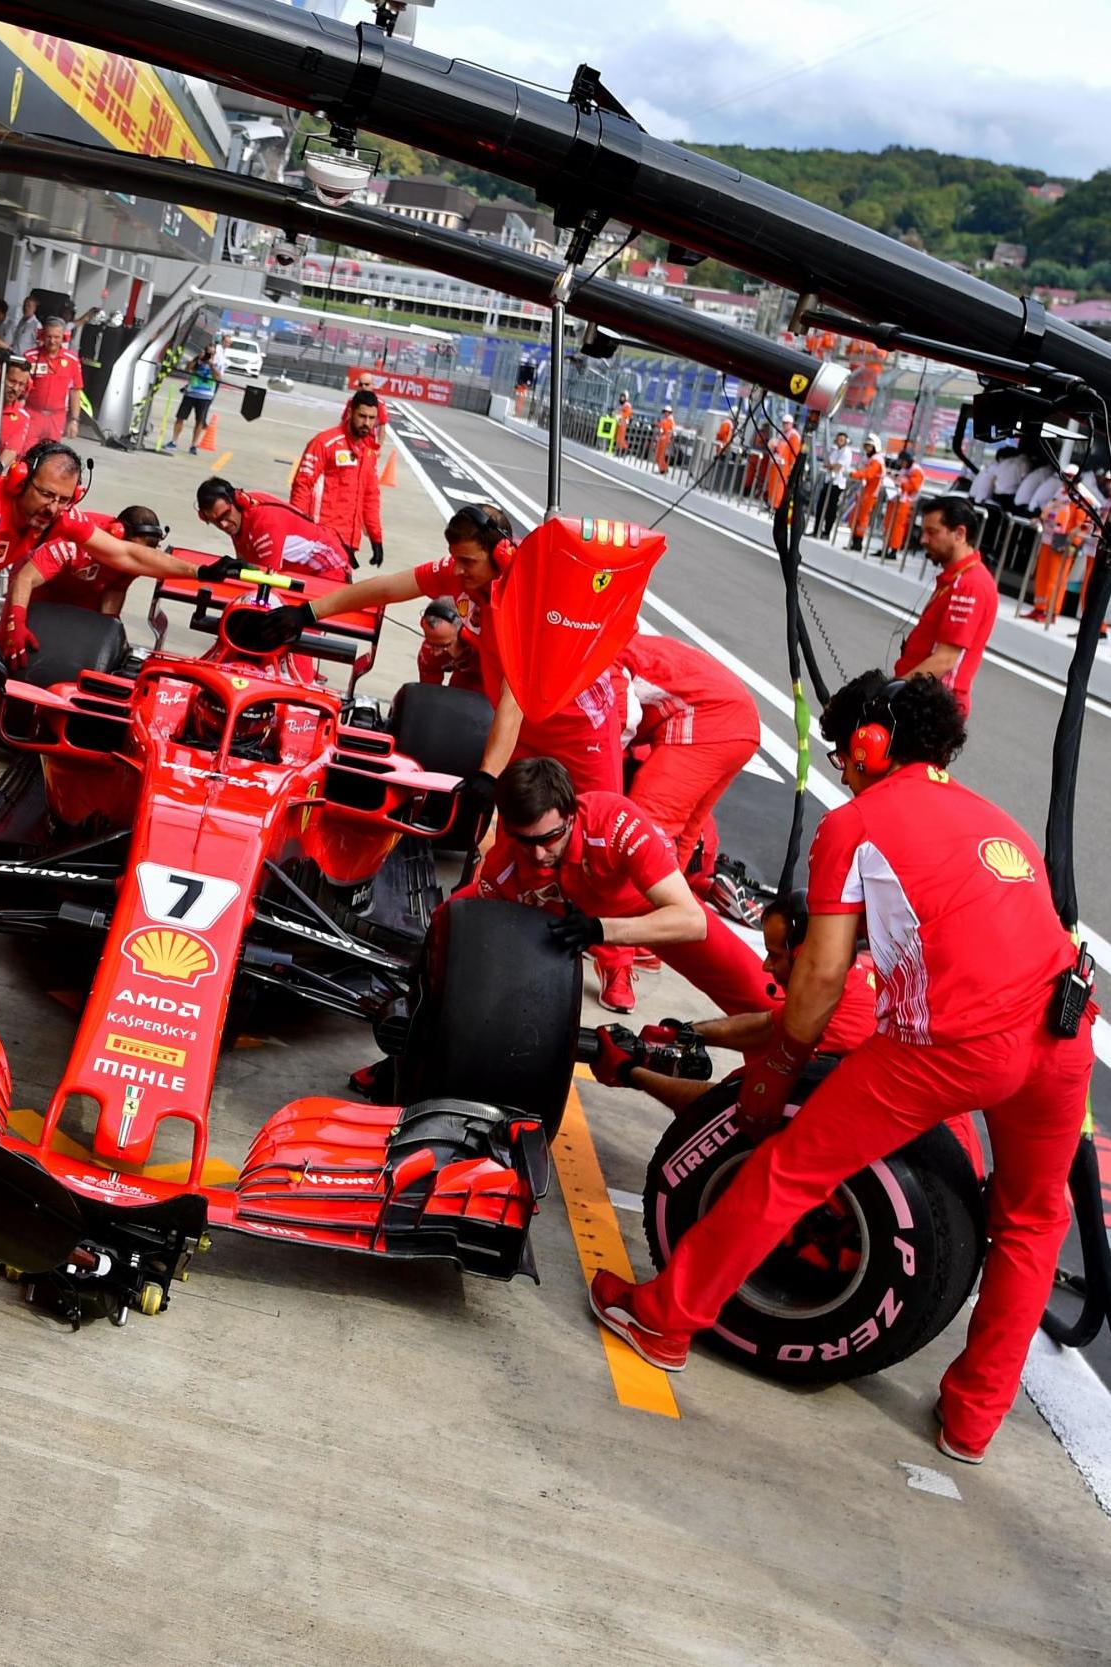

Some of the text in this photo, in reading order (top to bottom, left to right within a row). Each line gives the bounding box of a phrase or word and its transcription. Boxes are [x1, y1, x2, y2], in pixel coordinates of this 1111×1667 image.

[562, 617, 601, 631] brembo
[168, 874, 205, 919] 7
[271, 911, 371, 955] Lenovo
[115, 989, 178, 1013] AMD
[106, 1011, 190, 1039] KASPERSKY
[112, 1038, 180, 1062] PIRELLI
[93, 1057, 186, 1092] MAHLE
[661, 1103, 740, 1188] PIRELL
[304, 1172, 375, 1185] V-Power
[776, 1235, 916, 1362] P ZERO
